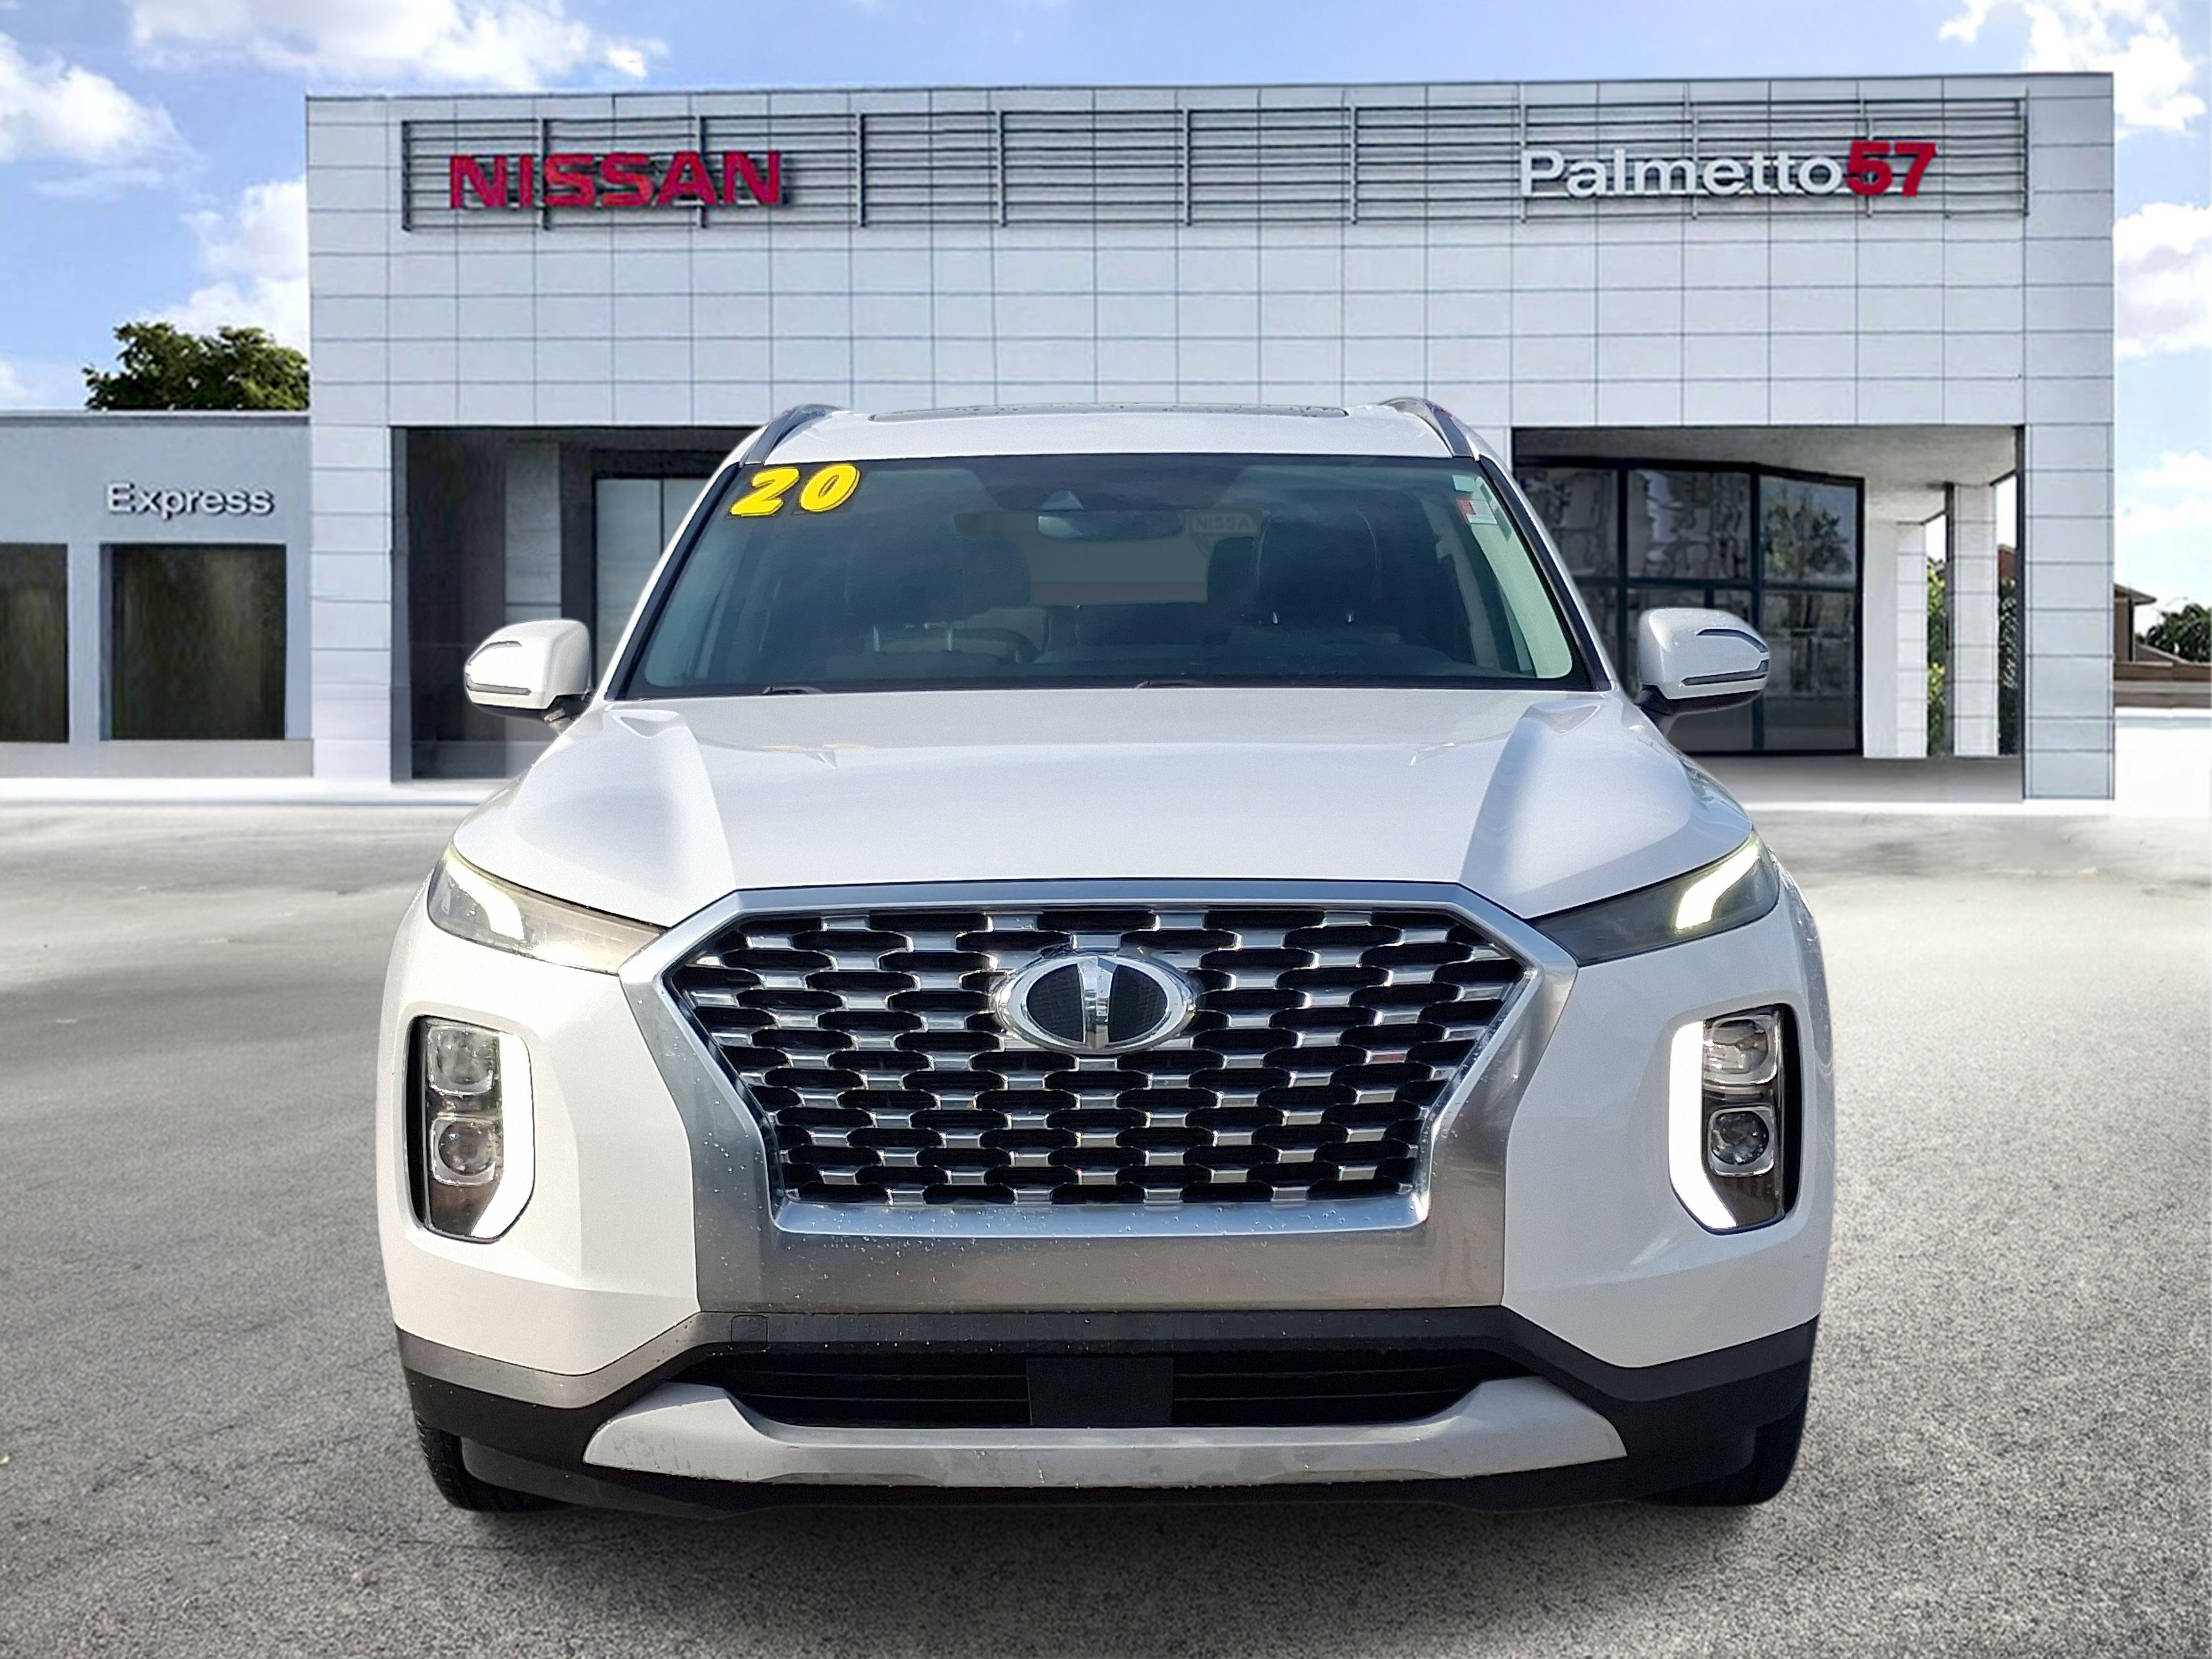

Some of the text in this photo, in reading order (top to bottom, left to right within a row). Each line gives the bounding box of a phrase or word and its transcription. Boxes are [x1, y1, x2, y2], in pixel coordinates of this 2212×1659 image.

[450, 151, 782, 209] NISSAN
[108, 483, 274, 520] Express
[729, 463, 860, 517] 20
